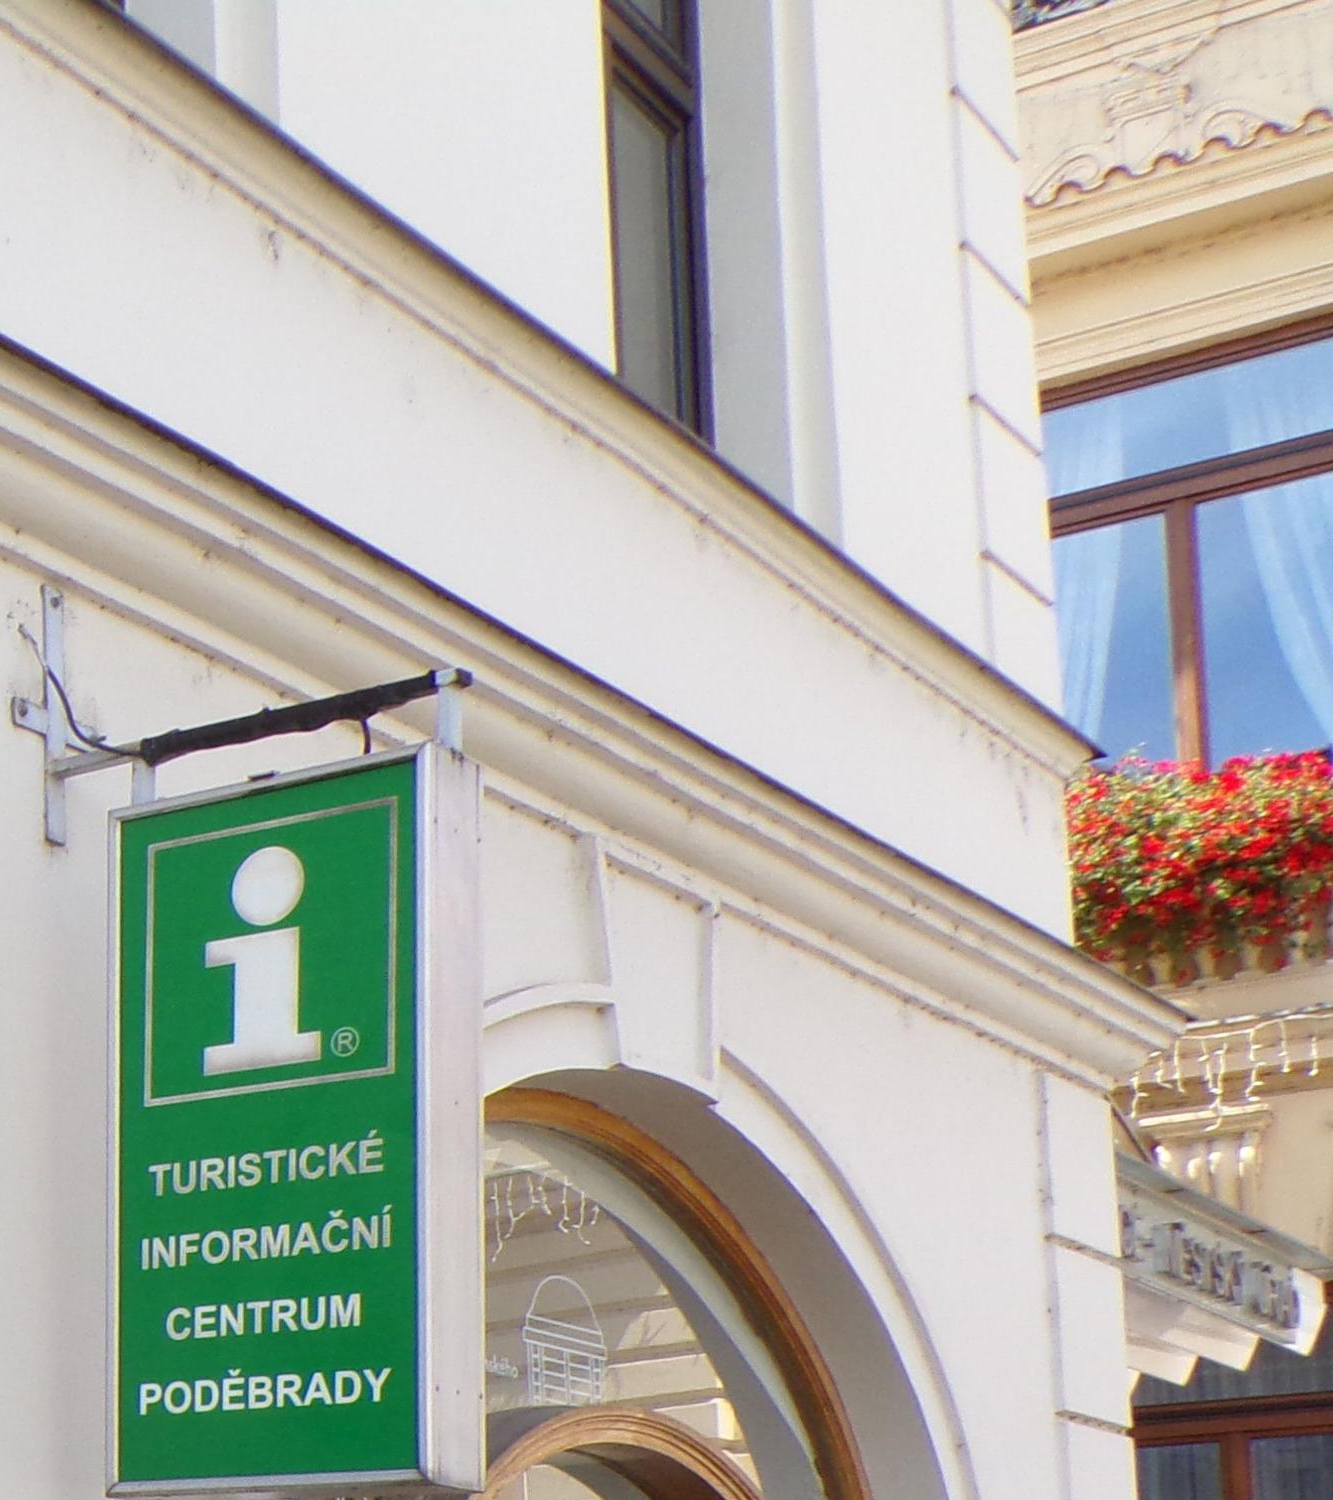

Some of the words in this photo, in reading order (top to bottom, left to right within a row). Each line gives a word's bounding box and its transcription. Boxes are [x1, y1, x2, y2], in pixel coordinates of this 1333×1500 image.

[148, 1130, 384, 1196] TURISTICKÉ
[141, 1204, 392, 1270] INFORMAČNÍ
[165, 1293, 361, 1341] CENTRUM
[138, 1367, 391, 1416] PODĚBRADY
